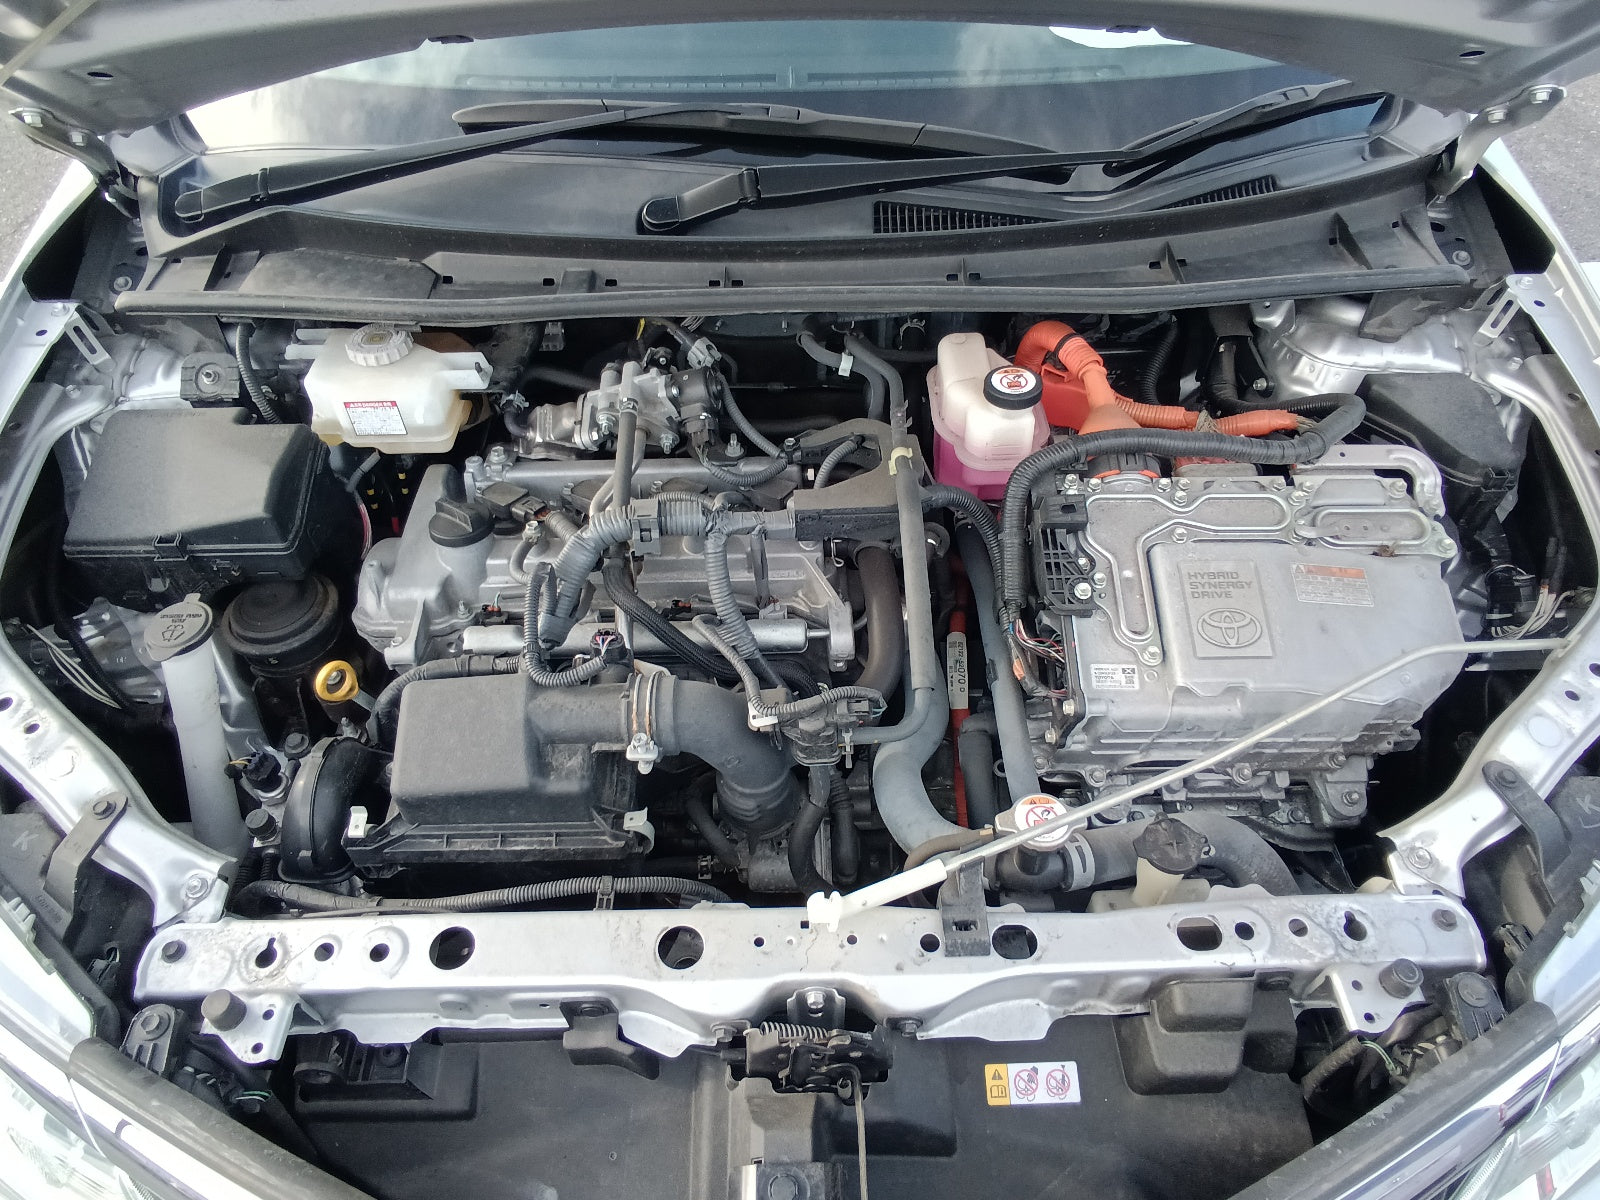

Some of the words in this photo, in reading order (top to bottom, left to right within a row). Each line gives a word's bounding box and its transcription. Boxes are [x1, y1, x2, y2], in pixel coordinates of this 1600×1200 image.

[1187, 571, 1239, 580] HYBRID
[1189, 581, 1253, 590] SYNERGY
[1191, 591, 1233, 599] DRIVE
